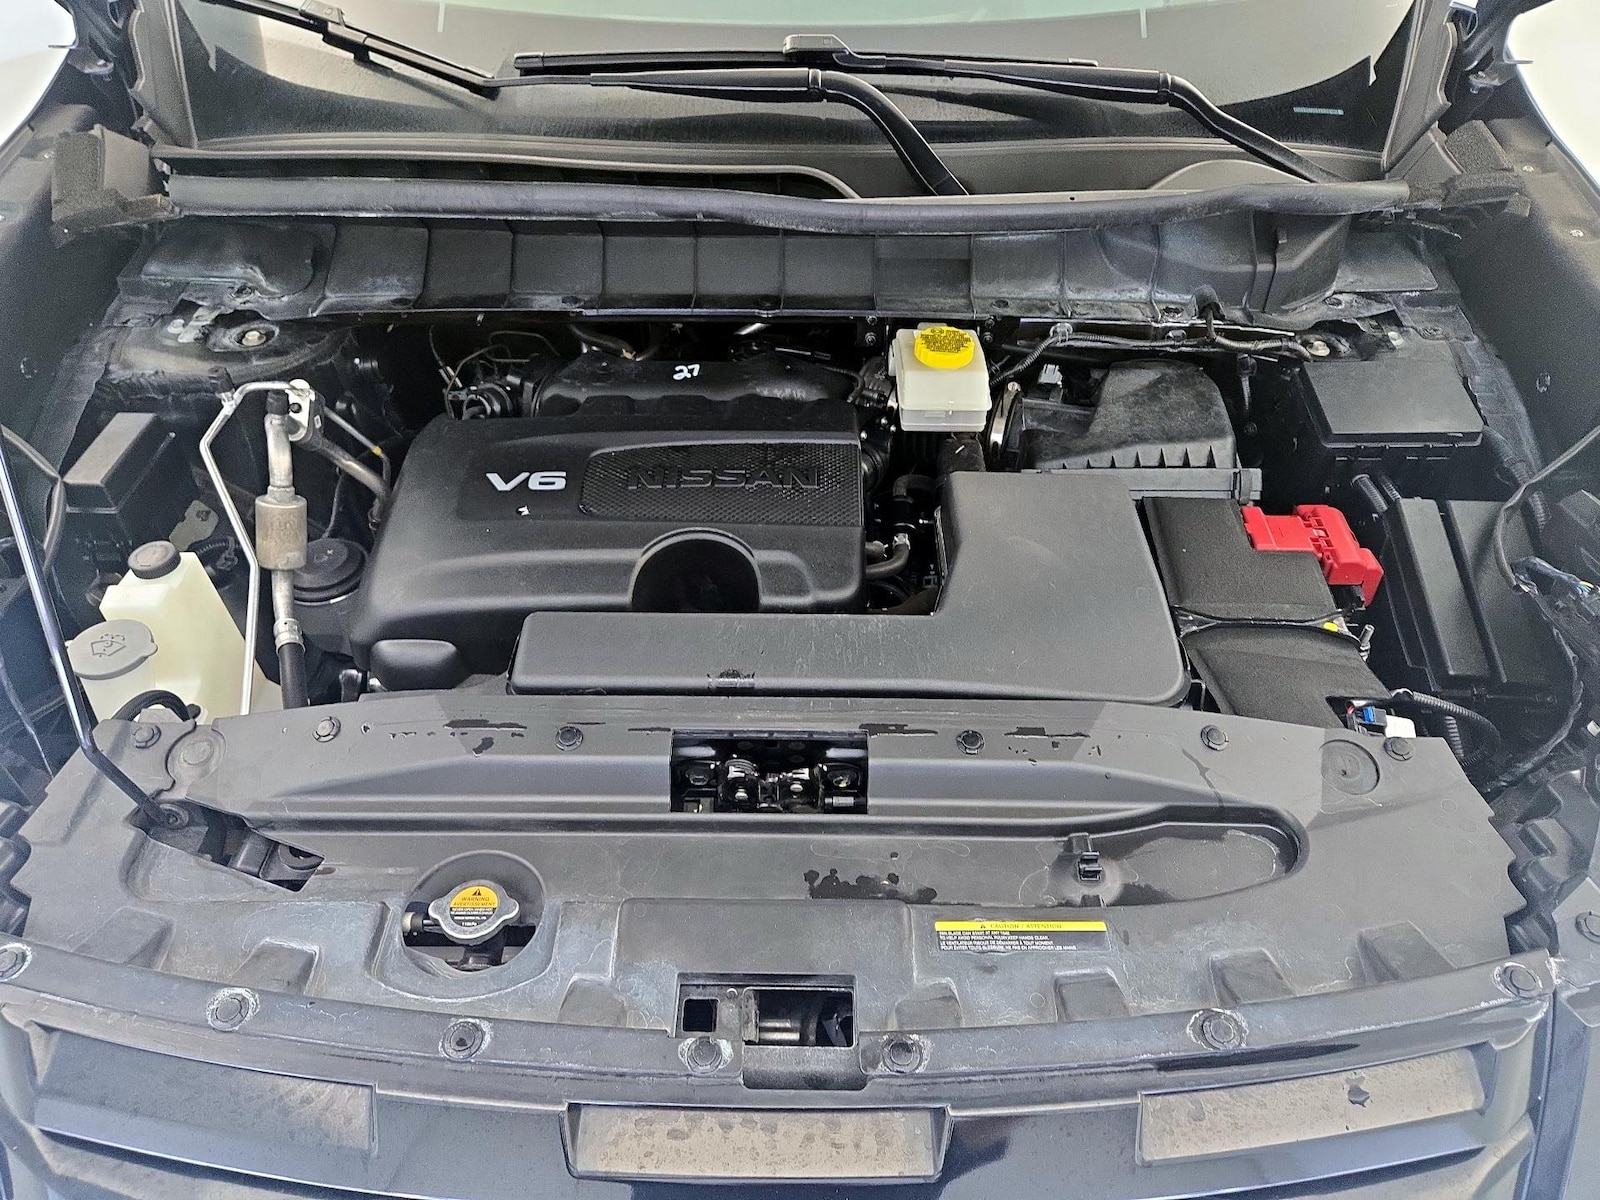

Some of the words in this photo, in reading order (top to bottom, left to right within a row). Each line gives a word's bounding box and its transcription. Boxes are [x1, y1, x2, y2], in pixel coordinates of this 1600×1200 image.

[673, 364, 701, 381] 27
[485, 470, 567, 492] V6
[628, 467, 820, 490] NISSAN
